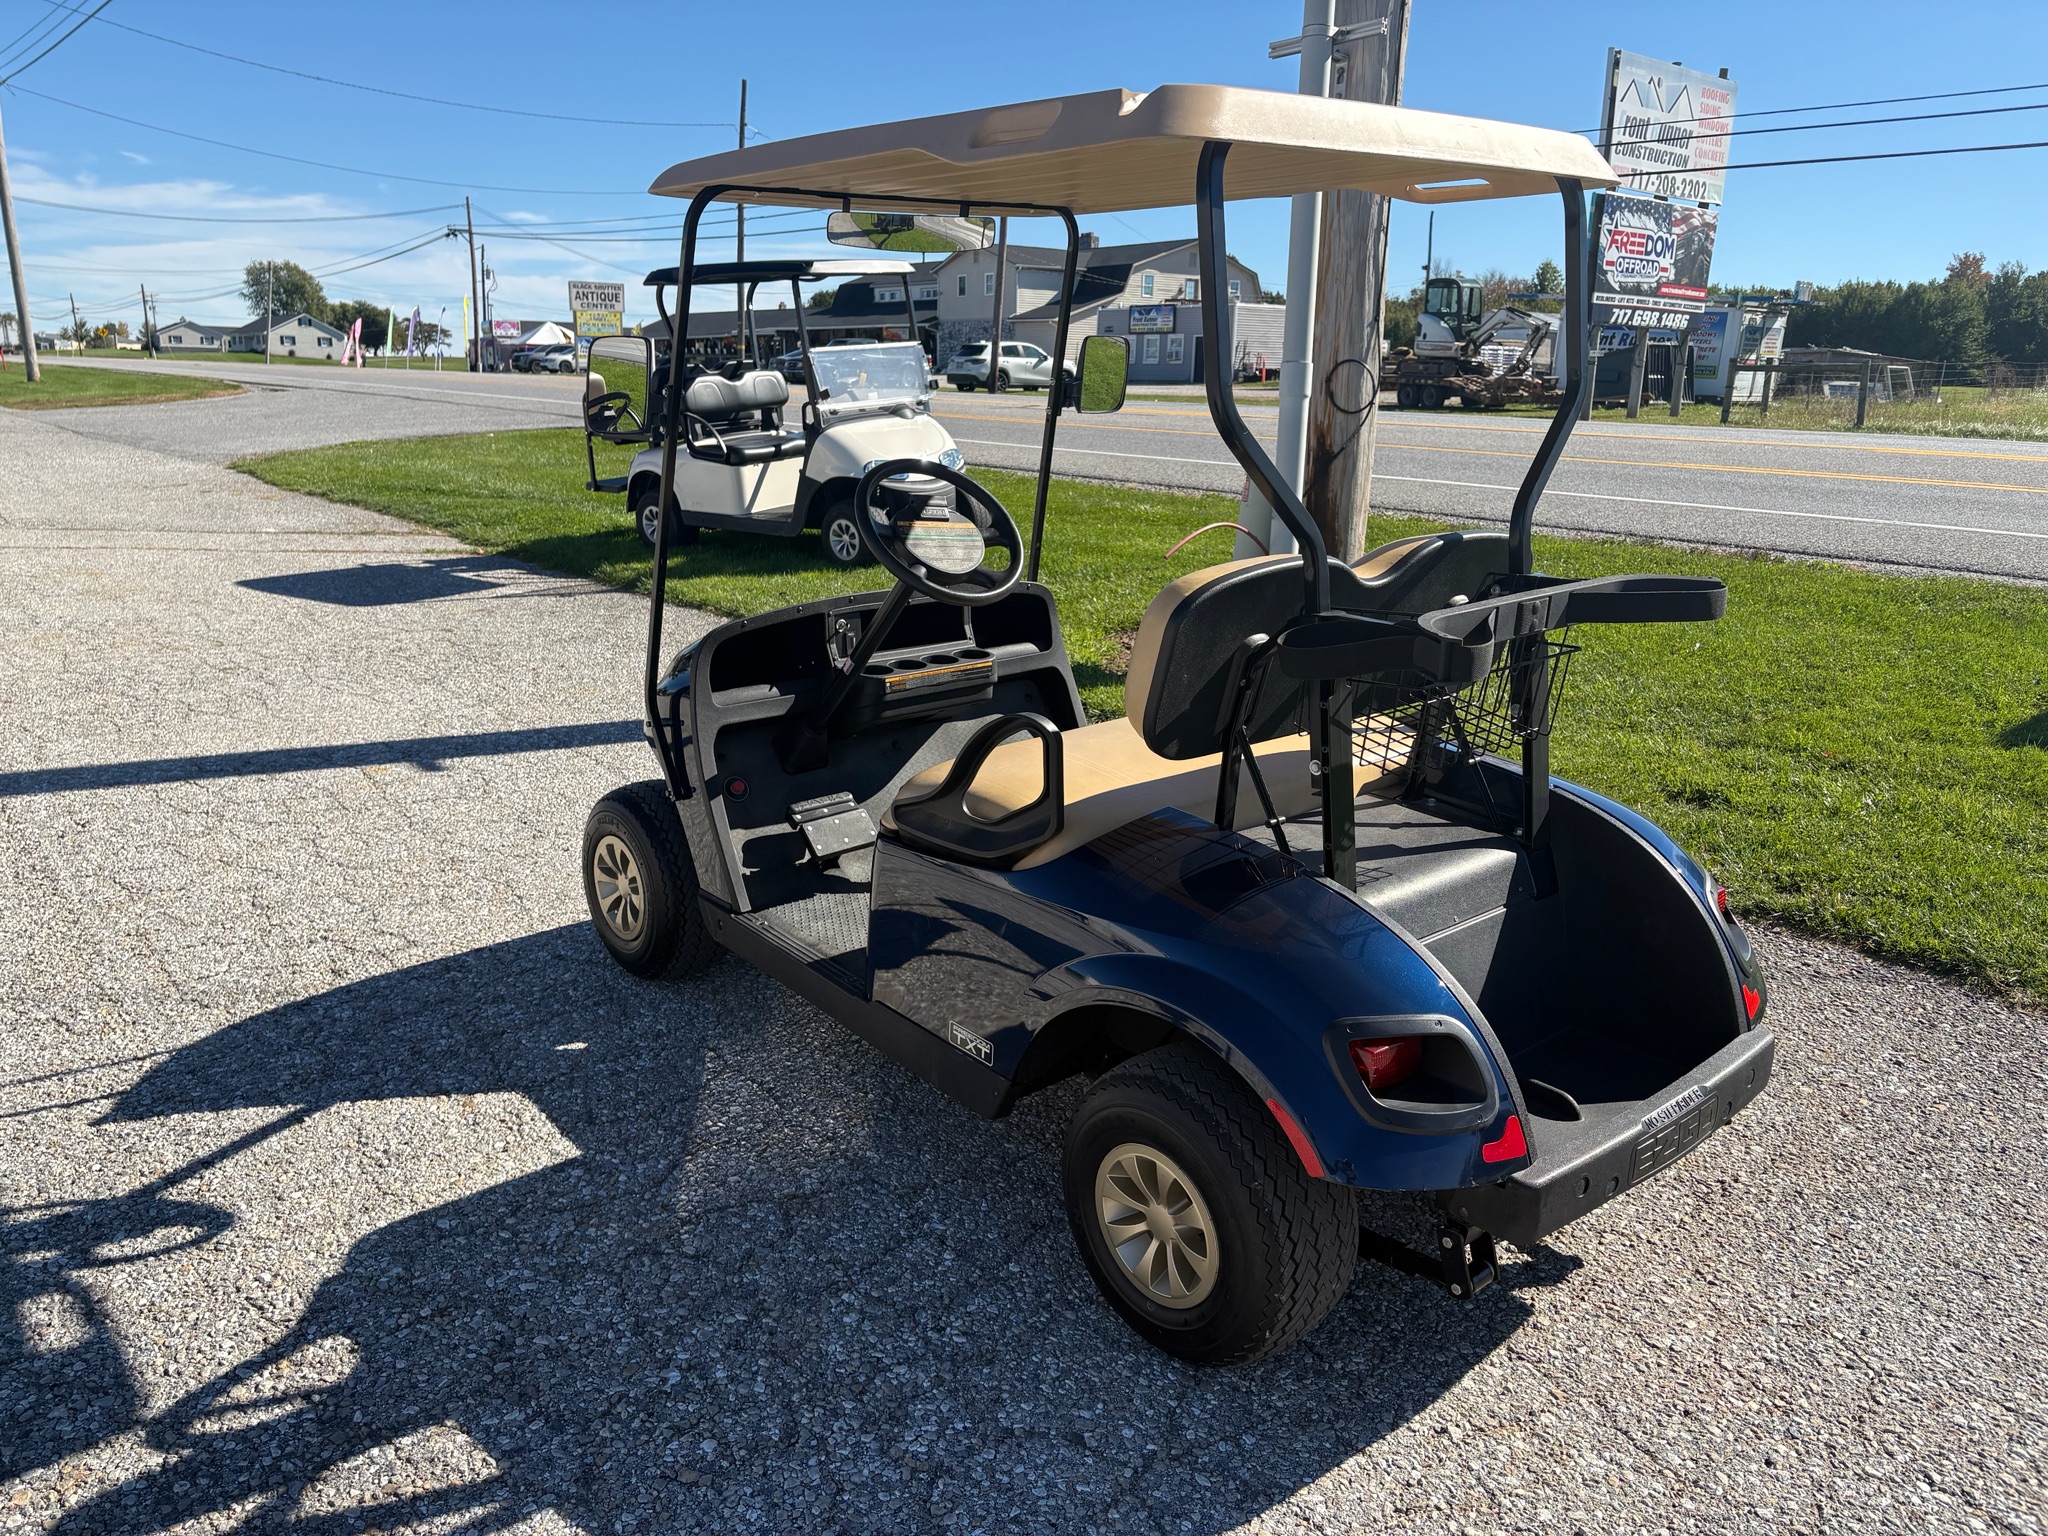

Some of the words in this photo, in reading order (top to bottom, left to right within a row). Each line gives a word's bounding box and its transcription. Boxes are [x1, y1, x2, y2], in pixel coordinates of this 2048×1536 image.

[1701, 86, 1730, 104] ROOFING
[1699, 101, 1722, 116] SIDING
[1698, 117, 1729, 133] WINDOWS
[1696, 131, 1723, 148] GUTTERS
[1614, 141, 1690, 169] CONSTRUCTION
[1694, 147, 1726, 164] CONCRETE
[1629, 167, 1707, 200] 717-208-2202
[1607, 229, 1675, 260] FREEDOM
[1616, 257, 1660, 275] OFFROAD
[572, 283, 592, 291] BLACK
[594, 284, 622, 292] SHUTTER
[575, 290, 621, 303] ANTIQUE
[580, 302, 616, 310] CENTER
[1609, 309, 1690, 329] 717.698.1486
[953, 1030, 990, 1059] TXT
[1644, 1116, 1659, 1131] NO
